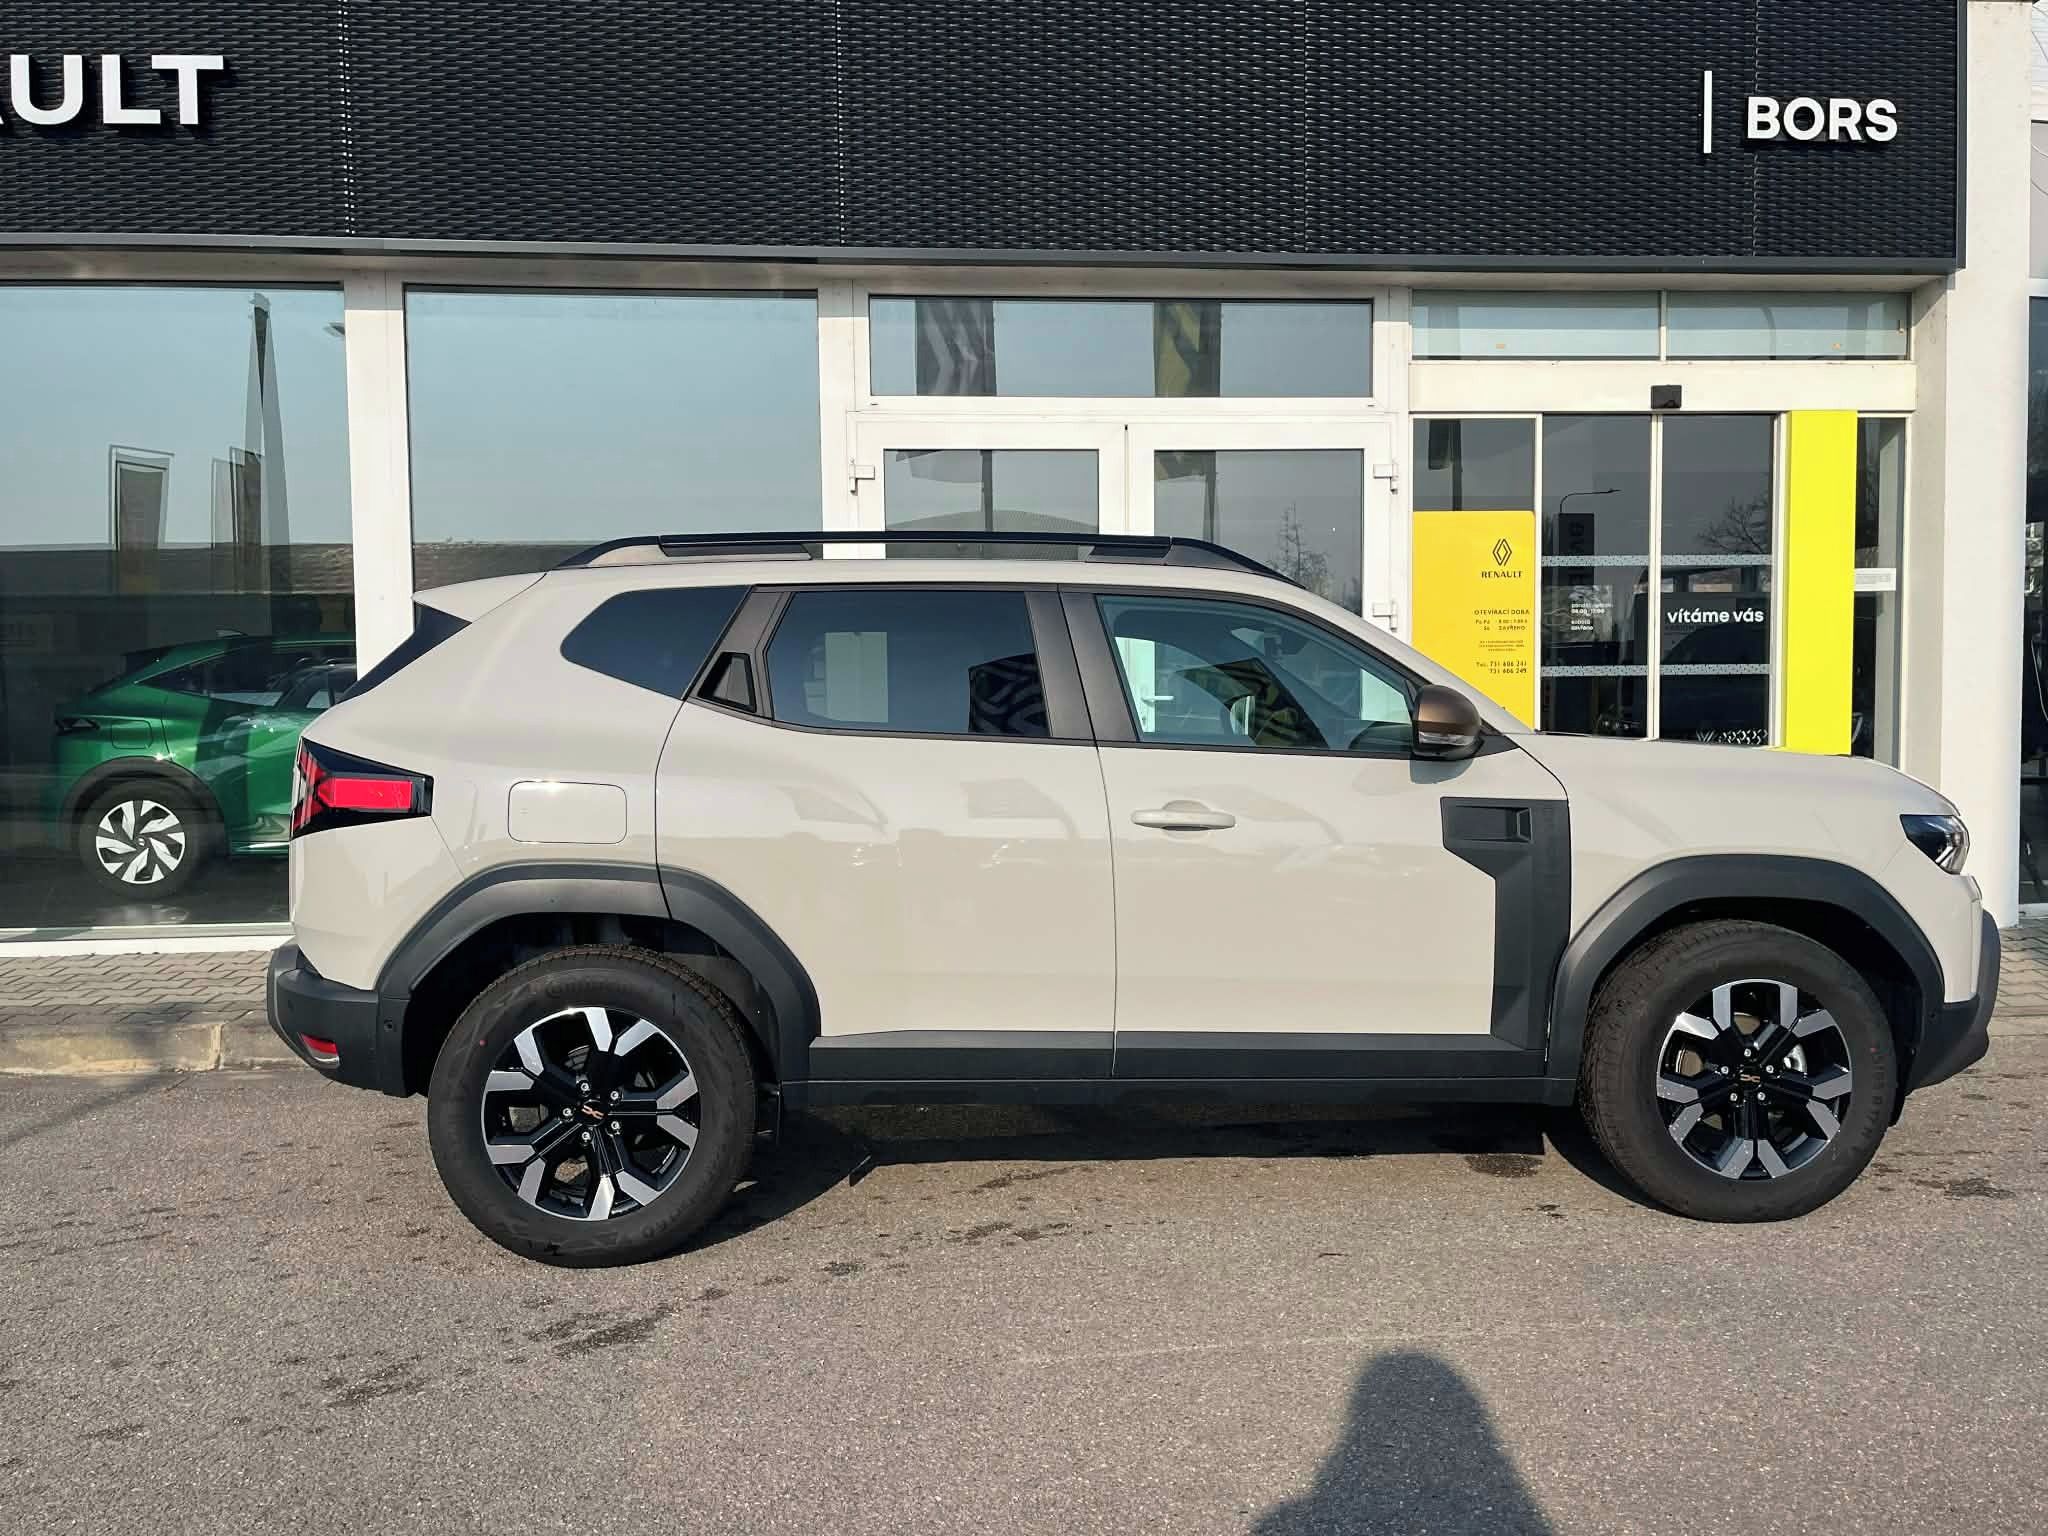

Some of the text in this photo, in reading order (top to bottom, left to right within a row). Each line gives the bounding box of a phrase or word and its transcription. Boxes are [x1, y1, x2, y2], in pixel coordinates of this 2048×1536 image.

[0, 54, 224, 125] ULT
[1747, 96, 1898, 142] BORS
[1481, 570, 1523, 579] RENAULT
[1667, 607, 1764, 623] vítáme vás
